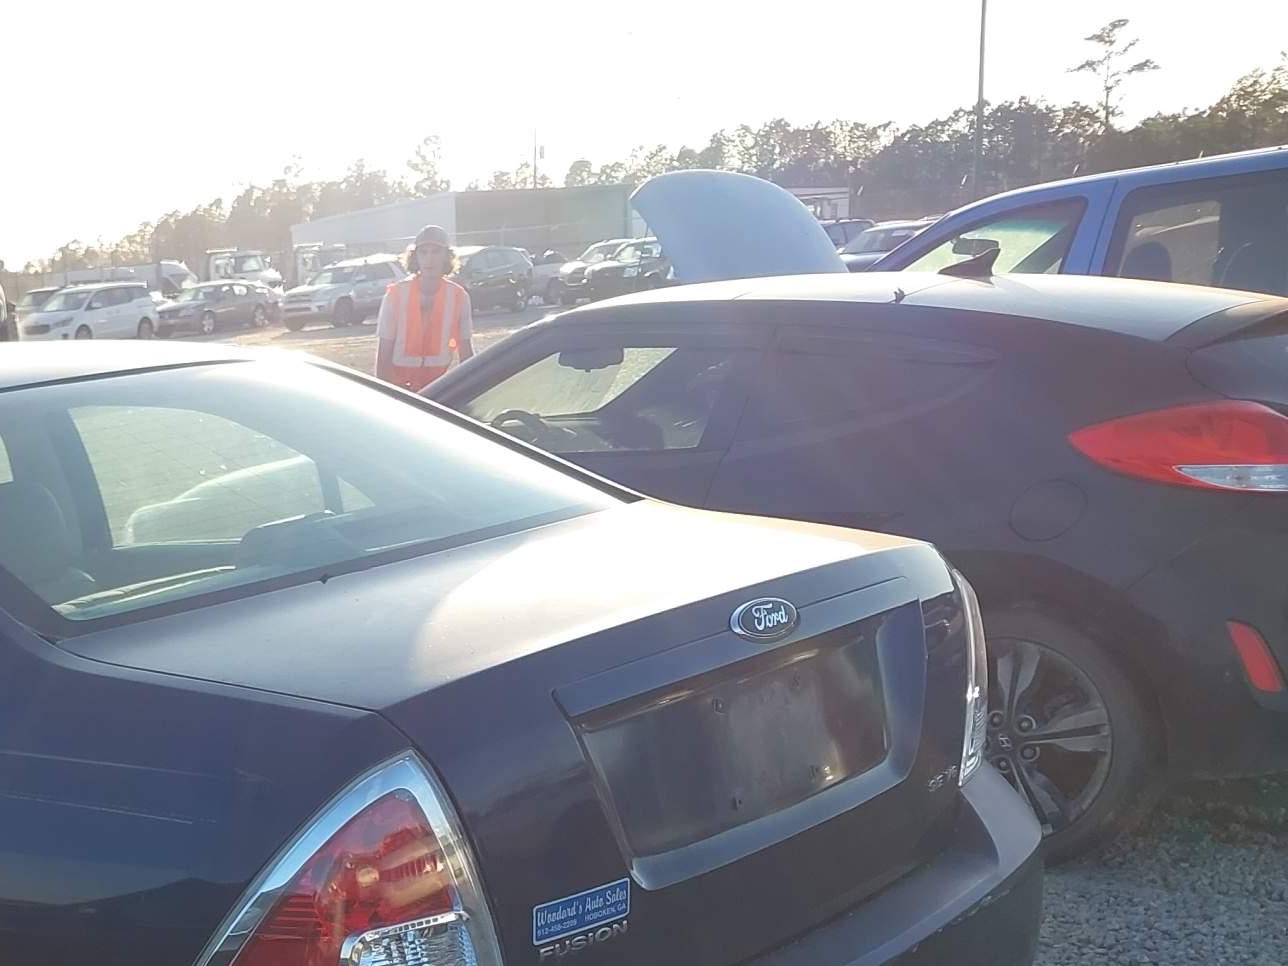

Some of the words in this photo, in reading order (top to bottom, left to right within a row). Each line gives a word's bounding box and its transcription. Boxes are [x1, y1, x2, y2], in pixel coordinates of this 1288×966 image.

[752, 603, 789, 631] Ford
[537, 901, 583, 927] Woodard's
[585, 896, 604, 912] Auto
[606, 887, 627, 905] Sales
[617, 903, 627, 912] GA
[539, 920, 629, 962] FUSION
